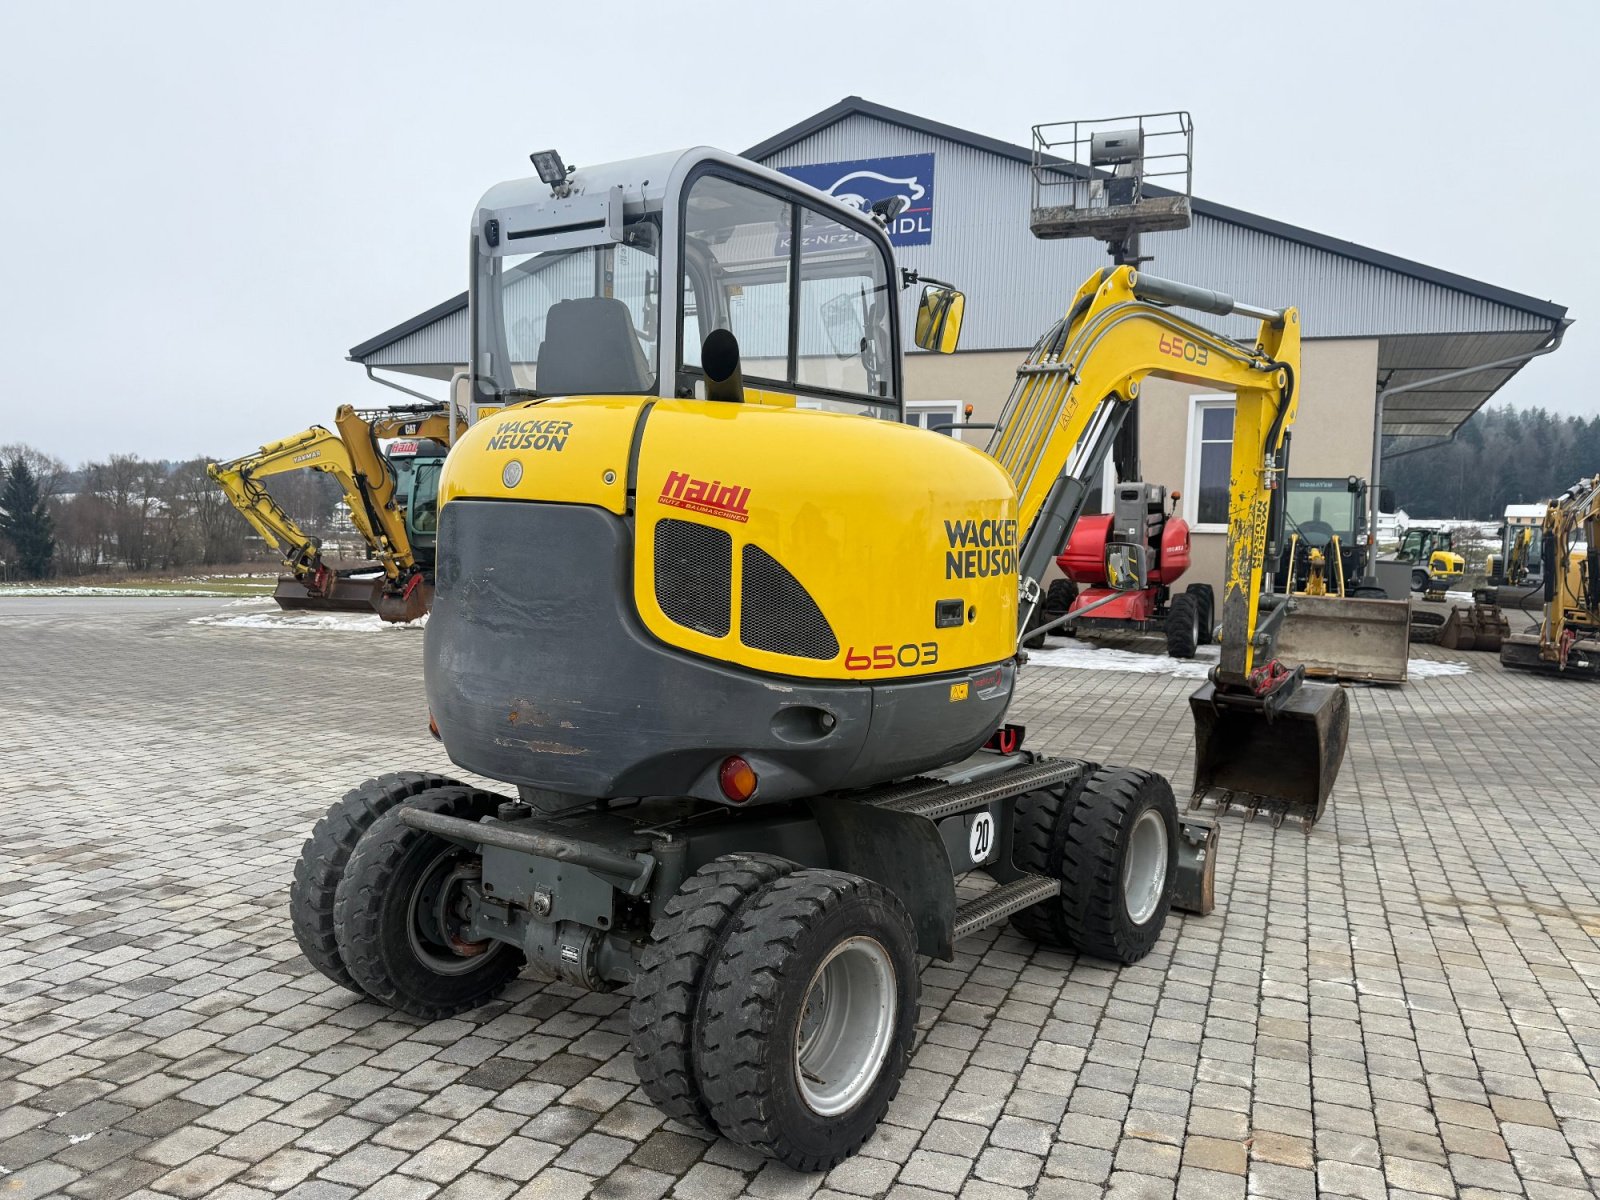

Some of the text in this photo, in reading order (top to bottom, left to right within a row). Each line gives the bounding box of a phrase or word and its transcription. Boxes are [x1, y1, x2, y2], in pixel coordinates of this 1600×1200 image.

[1159, 333, 1208, 366] 6503
[404, 423, 417, 435] CAT
[485, 434, 568, 452] NEUSON
[496, 420, 573, 436] WACKER
[293, 449, 321, 464] YANMAR
[661, 470, 752, 516] Haidl
[659, 497, 748, 522] NUTZ BAUMASCHINEN
[943, 519, 1018, 549] WACKER
[1253, 501, 1263, 568] NEUSON
[1257, 501, 1268, 568] WACKER
[945, 548, 1018, 580] NEUSON
[844, 642, 938, 671] 6503
[974, 818, 990, 856] 20
